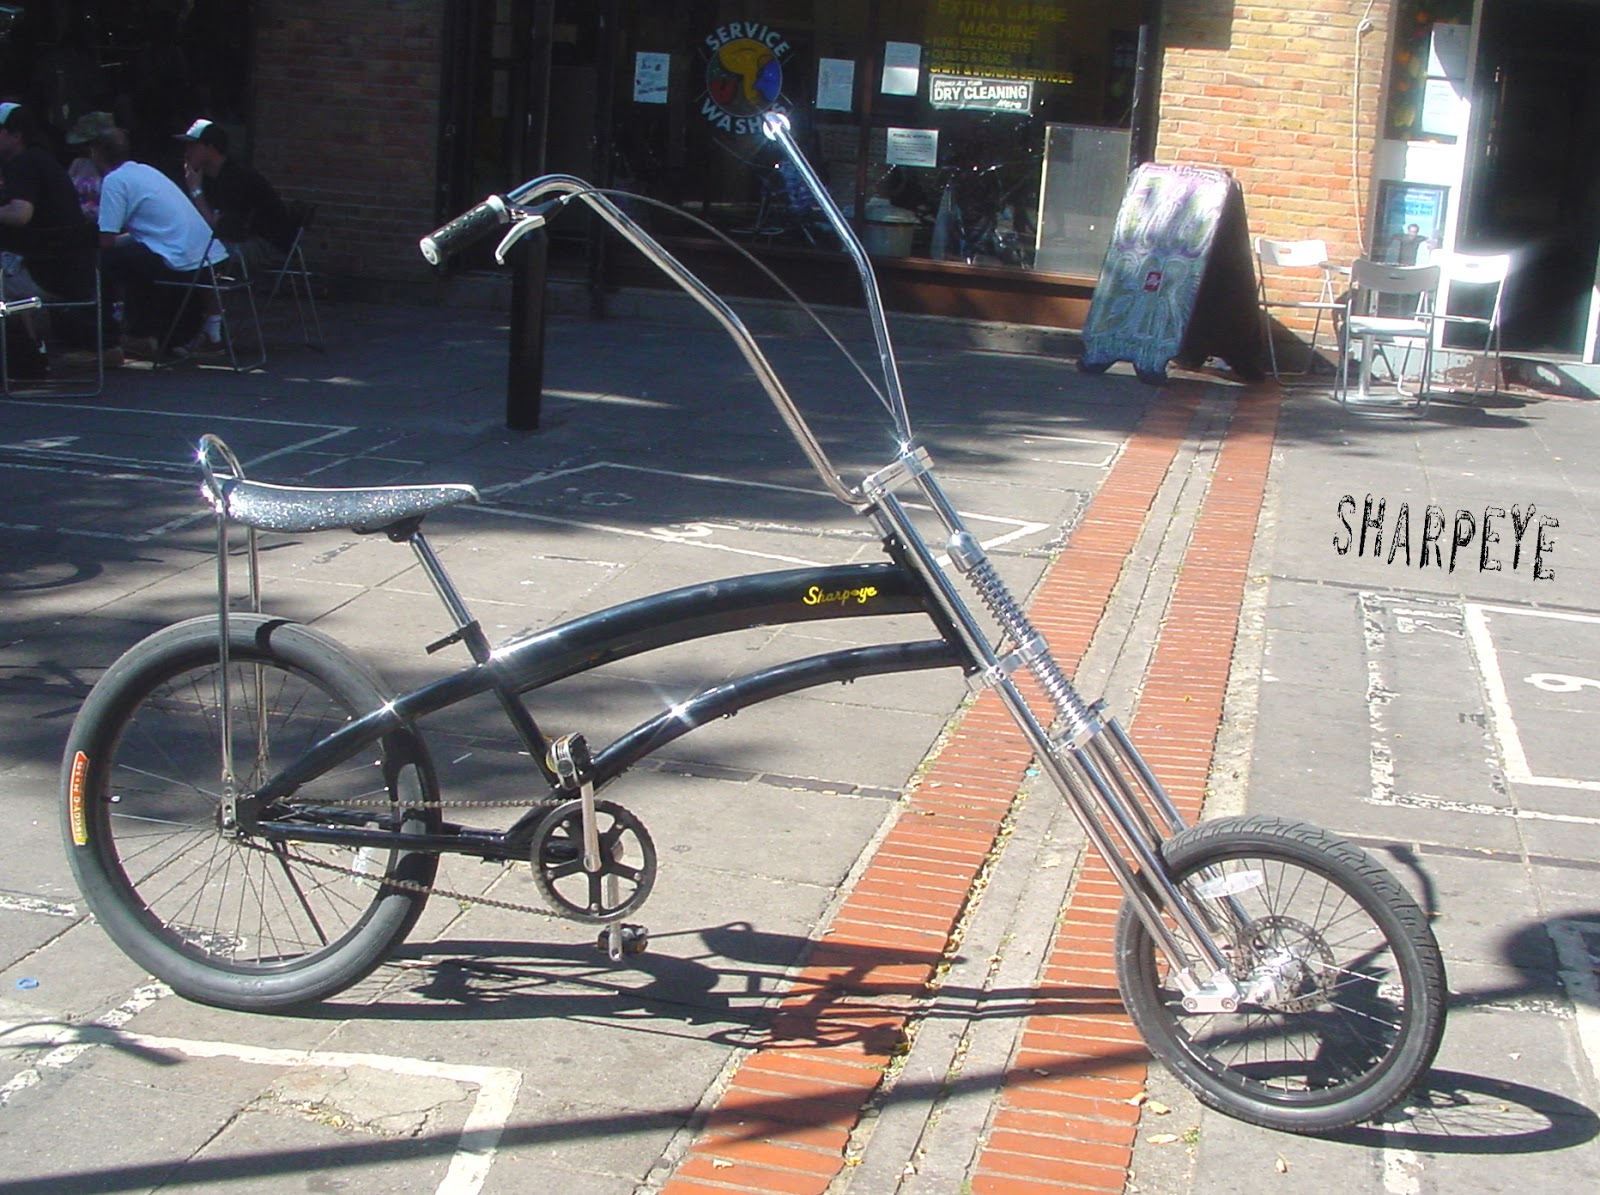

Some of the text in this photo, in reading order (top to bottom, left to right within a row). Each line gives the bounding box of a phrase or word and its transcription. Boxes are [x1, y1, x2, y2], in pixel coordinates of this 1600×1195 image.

[938, 0, 1068, 23] EXTRA LARGE
[705, 21, 790, 57] SERVICE
[960, 20, 1040, 40] MACHINE
[934, 85, 1027, 101] DRY CLEANING
[701, 98, 787, 134] WASHS
[802, 585, 878, 606] Sharpeye
